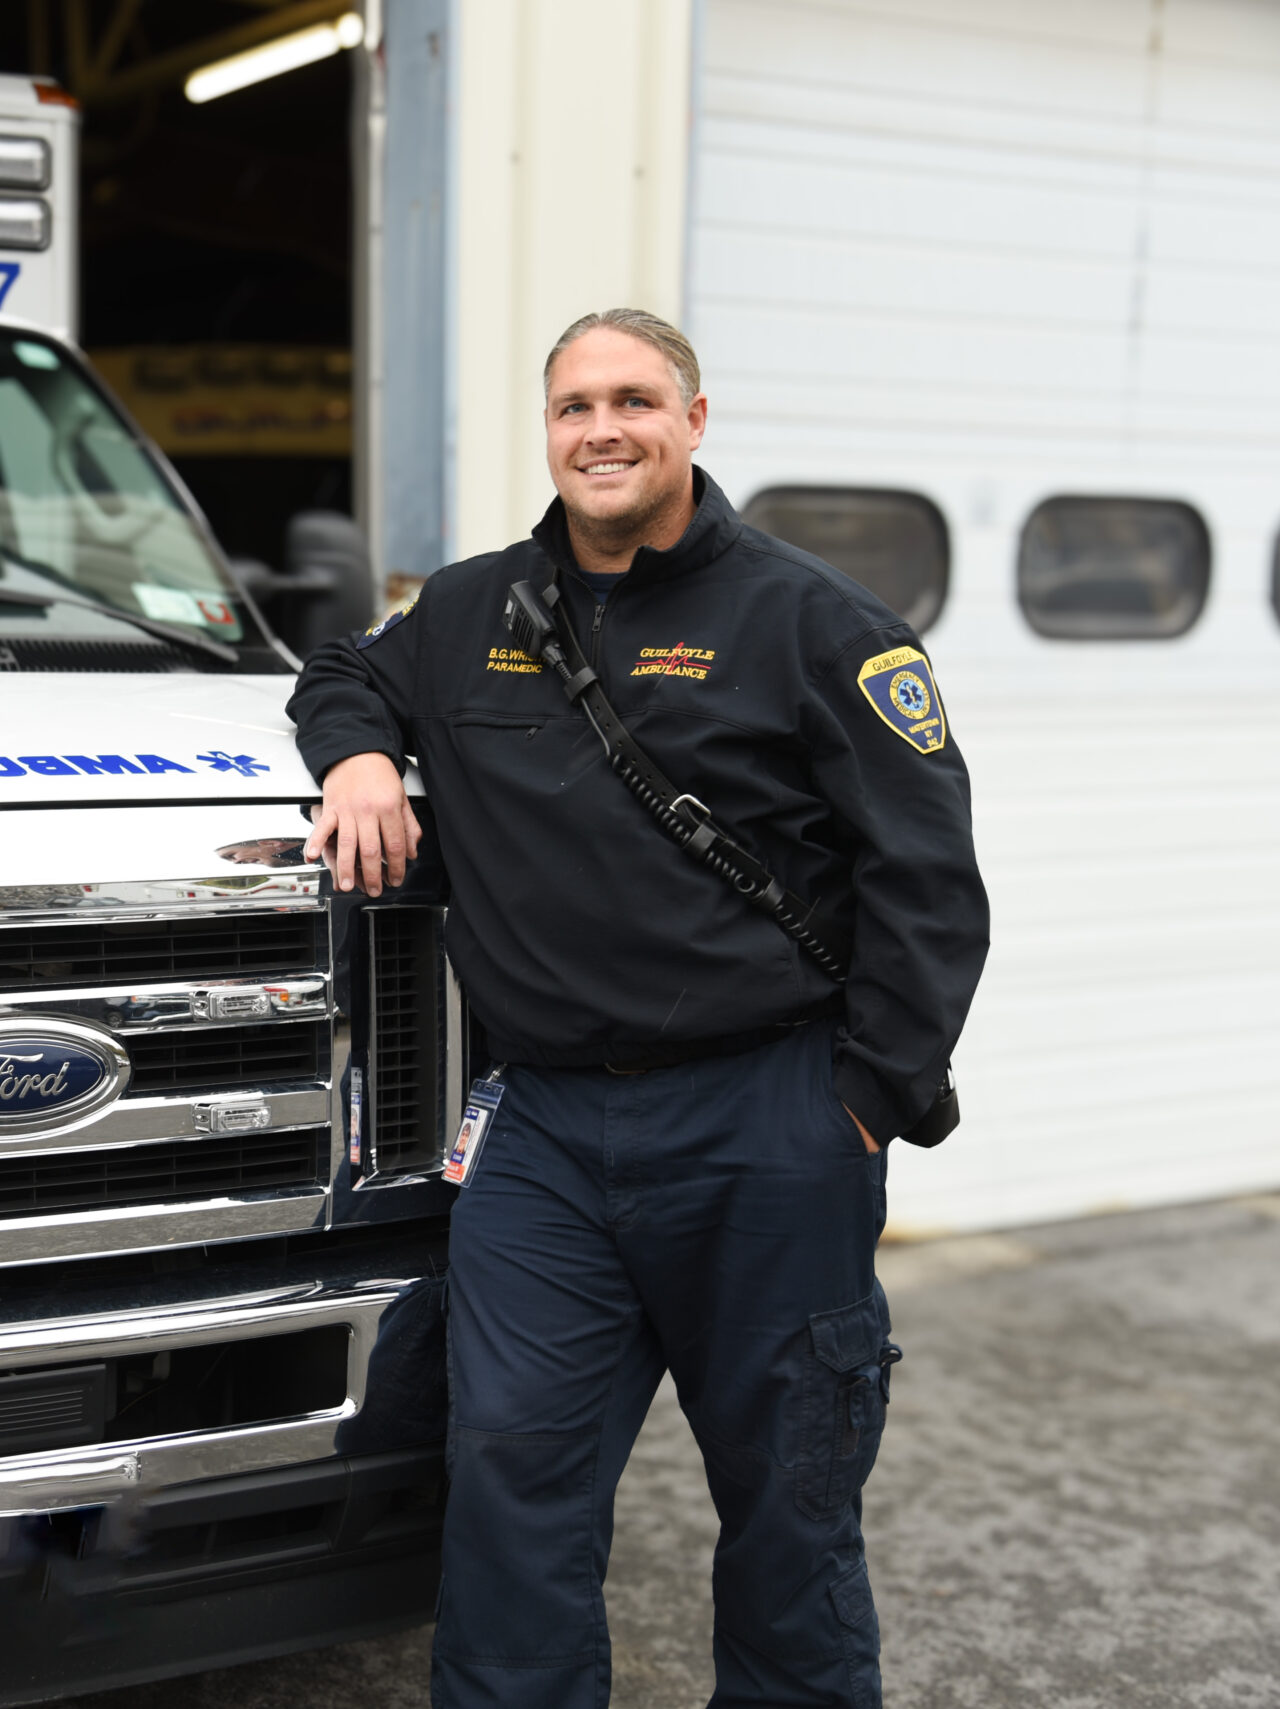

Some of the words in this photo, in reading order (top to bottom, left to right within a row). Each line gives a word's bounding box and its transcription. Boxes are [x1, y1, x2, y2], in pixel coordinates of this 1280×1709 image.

[640, 647, 716, 661] GUILFOYLE
[486, 661, 543, 674] PARAMEDIC
[630, 663, 708, 680] AMBULANCE
